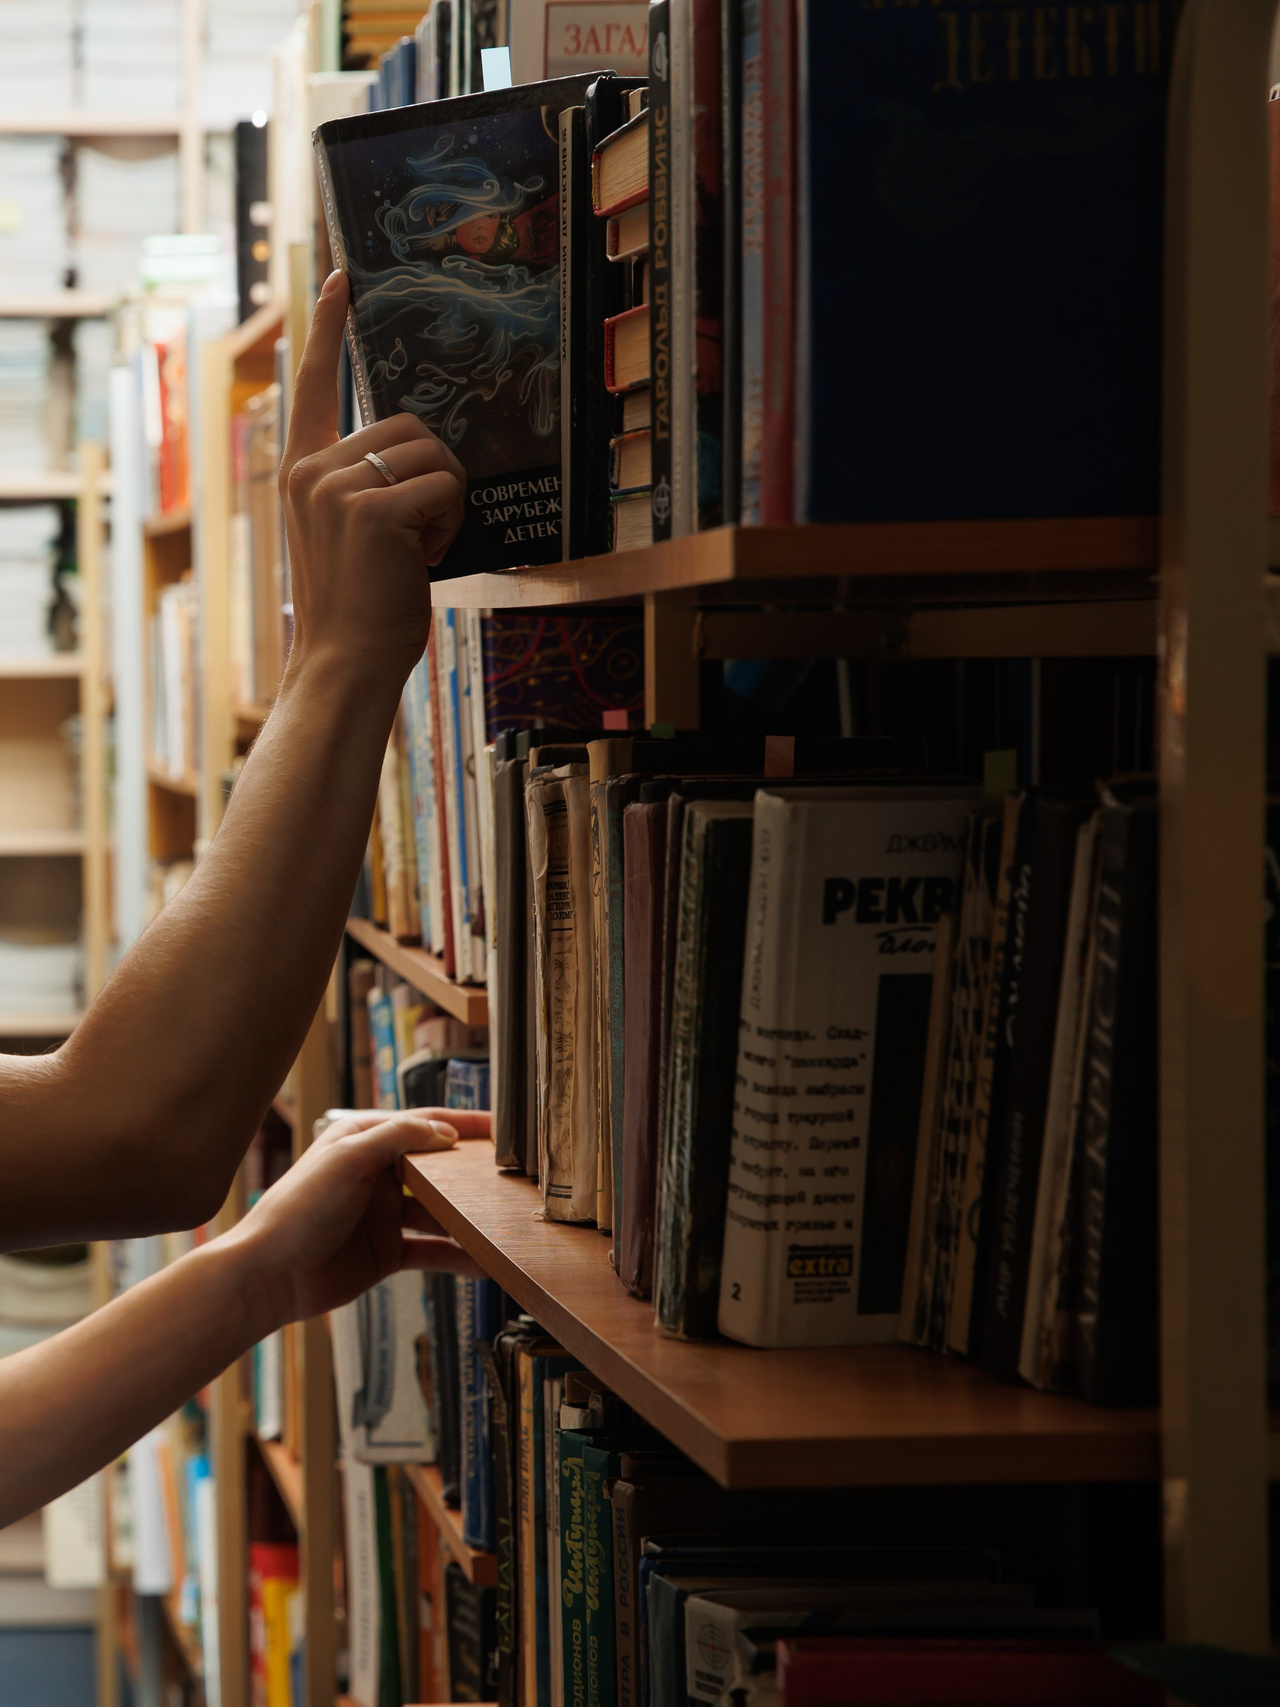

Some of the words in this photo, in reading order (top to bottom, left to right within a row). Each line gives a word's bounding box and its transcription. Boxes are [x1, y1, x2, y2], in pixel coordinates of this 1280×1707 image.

[932, 1, 1178, 94] ДЕТЕКТИ
[560, 146, 568, 237] ДЕТЕКТИВ
[653, 105, 669, 270] РОББИНС
[560, 245, 568, 363] ЗАРУБЕЖНЫЙ
[654, 282, 670, 440] ГАРОЛЬД
[481, 497, 562, 526] ЗАРУБЕЖ
[823, 876, 964, 924] РЕКВ
[731, 1282, 741, 1301] 2
[788, 1257, 851, 1276] extra
[615, 1507, 630, 1608] РОССИИ
[620, 1621, 631, 1637] В
